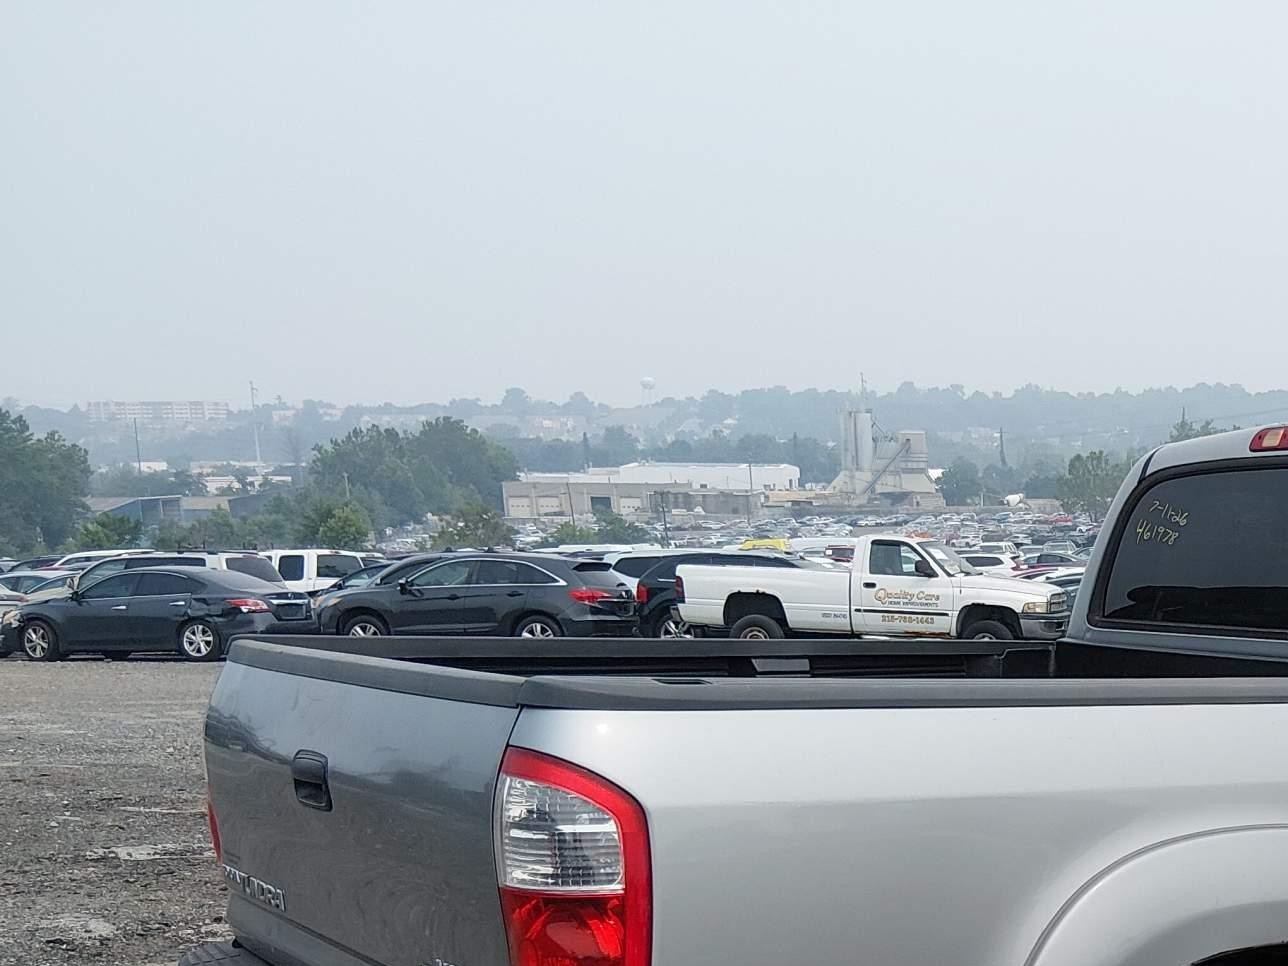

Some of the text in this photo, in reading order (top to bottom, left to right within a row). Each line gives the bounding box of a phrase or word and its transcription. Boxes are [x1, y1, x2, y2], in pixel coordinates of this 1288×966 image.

[1136, 519, 1179, 545] 461978
[874, 588, 940, 605] Quality Care
